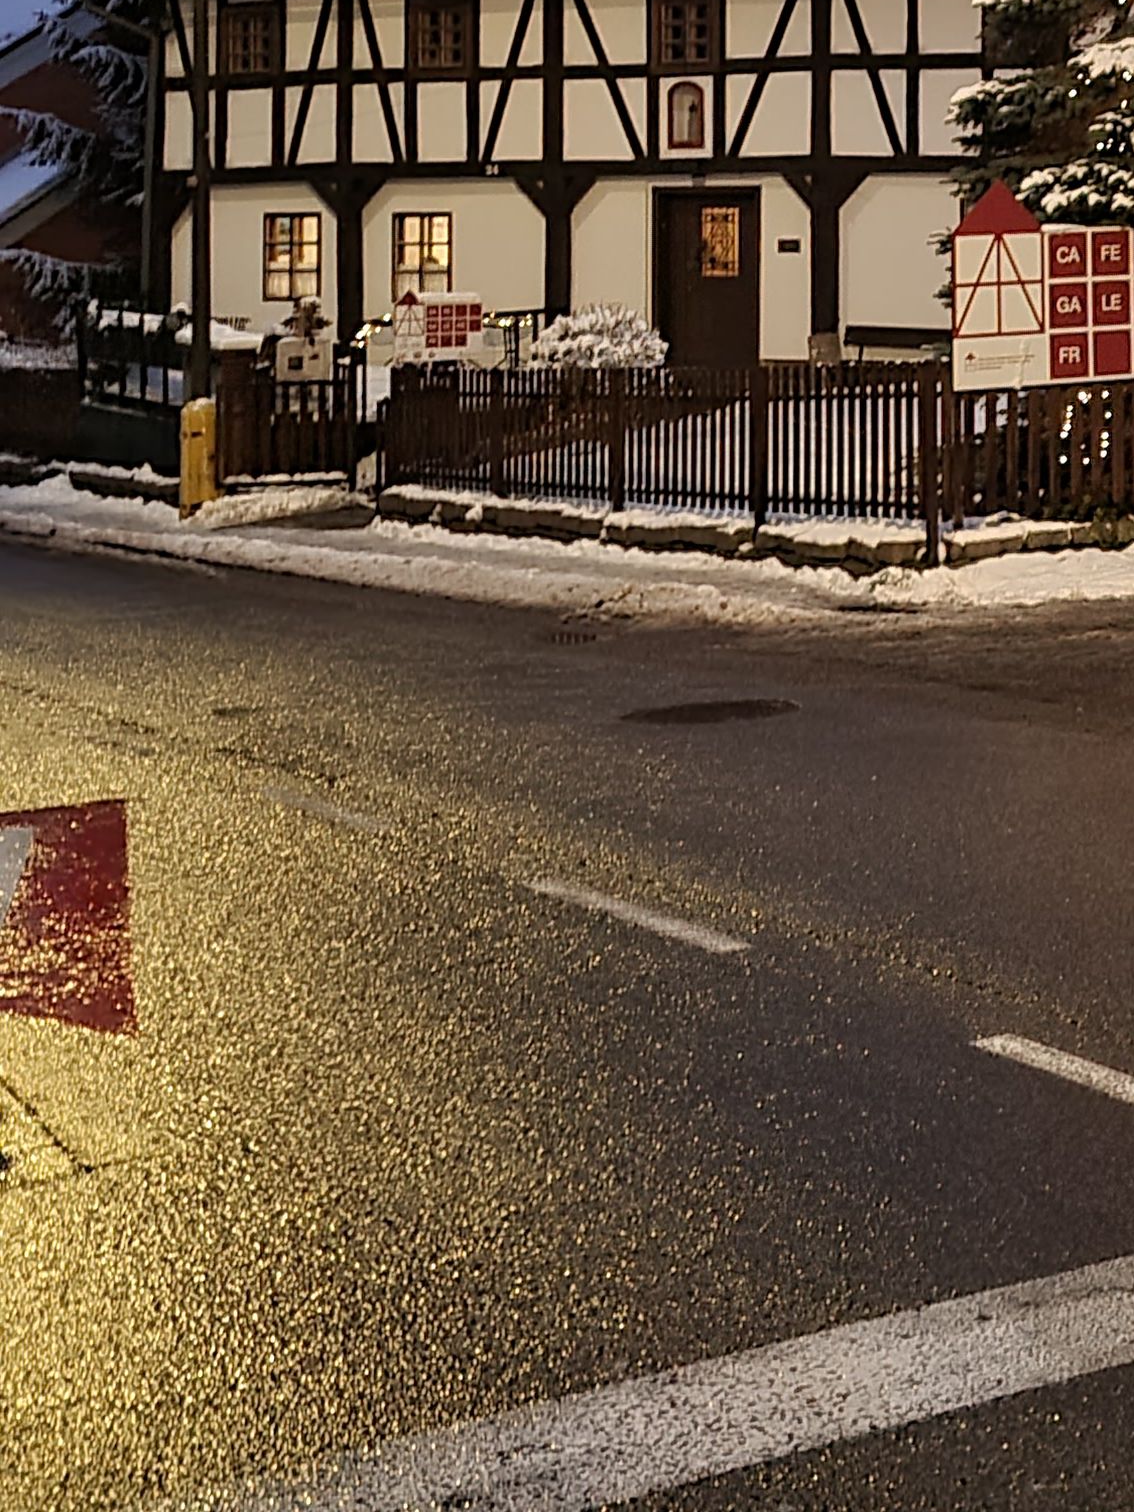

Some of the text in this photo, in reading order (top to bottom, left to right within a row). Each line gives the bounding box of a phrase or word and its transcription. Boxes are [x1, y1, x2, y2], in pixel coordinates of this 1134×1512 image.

[1056, 244, 1121, 263] CA FE
[1056, 296, 1082, 313] GA
[1101, 293, 1122, 311] LE
[1058, 346, 1080, 364] FR
